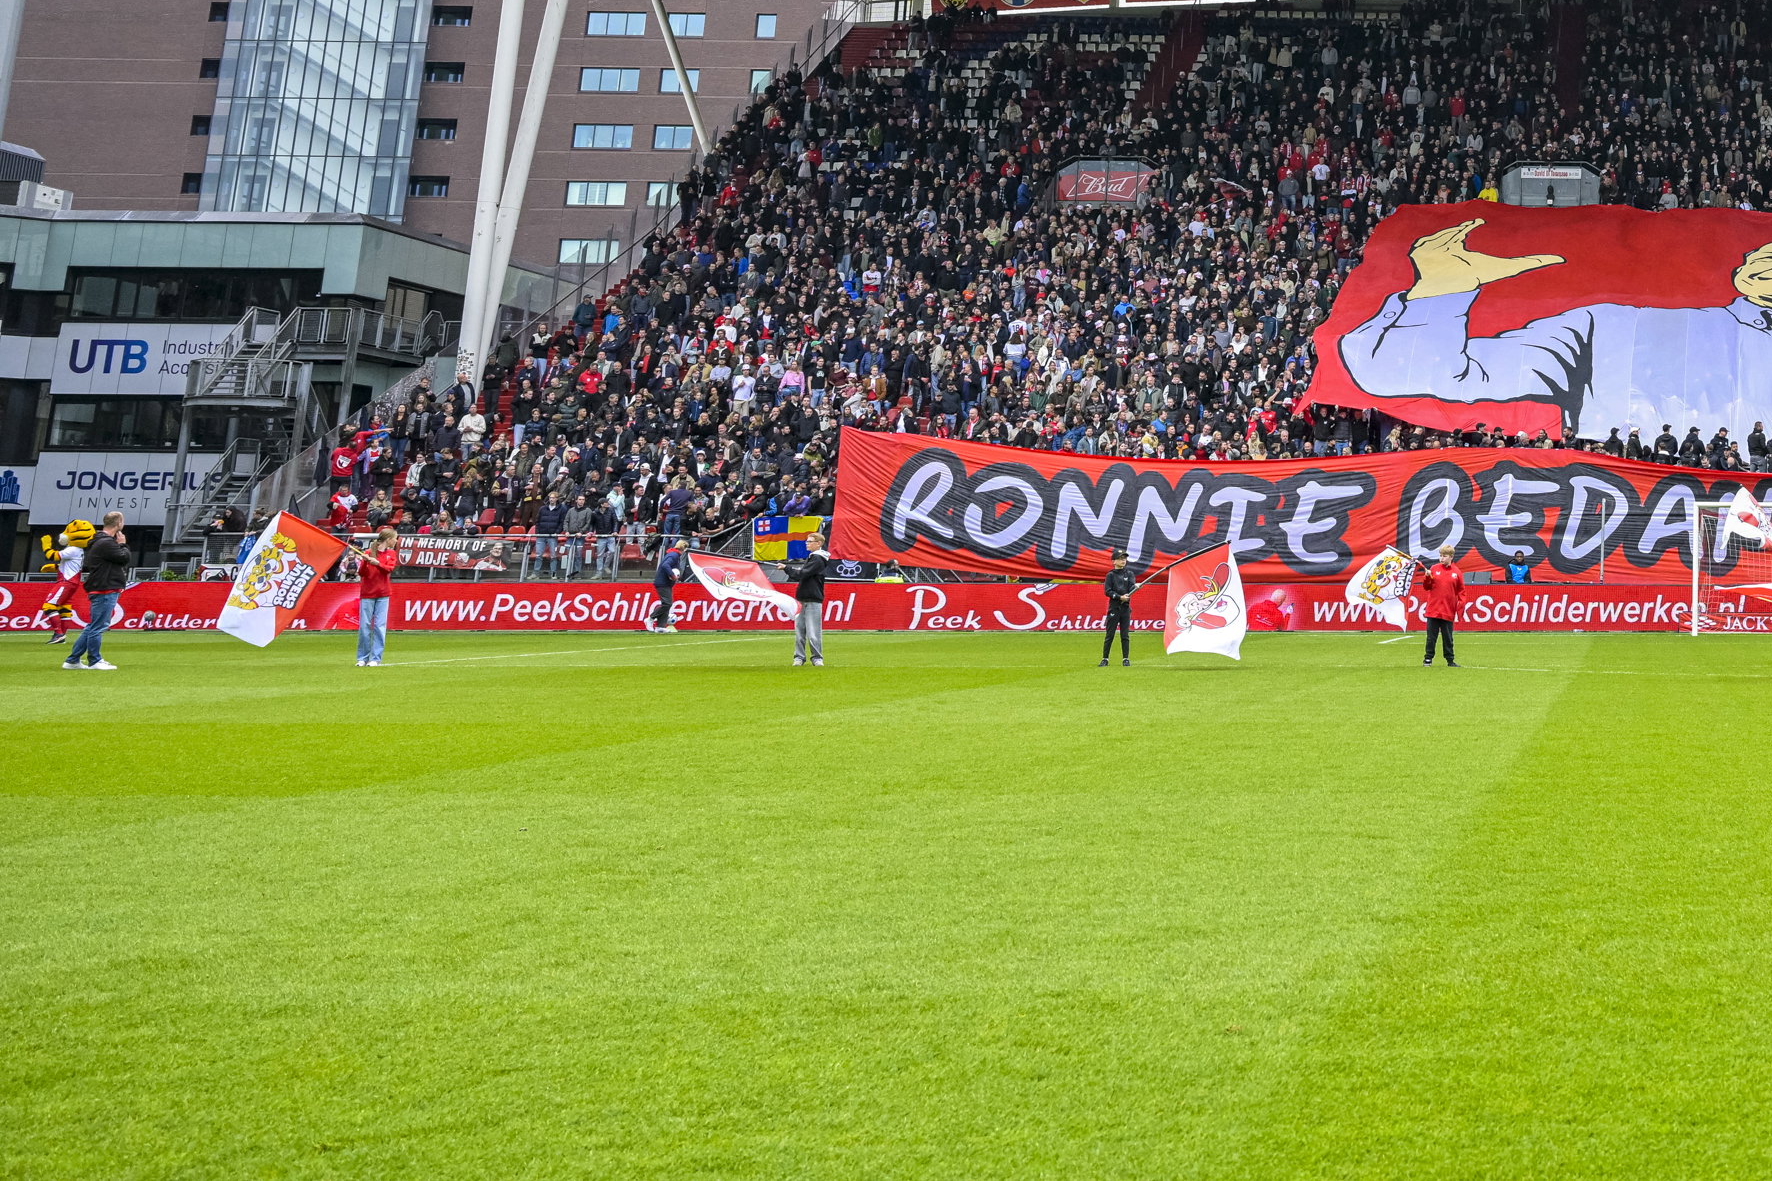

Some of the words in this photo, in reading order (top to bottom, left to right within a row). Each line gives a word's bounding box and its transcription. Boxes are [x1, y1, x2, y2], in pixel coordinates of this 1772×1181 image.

[1083, 176, 1125, 193] Bud
[69, 339, 149, 374] UTB
[78, 497, 151, 509] INVEST
[890, 459, 1366, 565] RONNIE
[400, 537, 414, 548] IN
[417, 538, 469, 550] MEMORY
[472, 540, 487, 551] OF
[416, 551, 450, 566] ADJE
[904, 585, 983, 631] Peek
